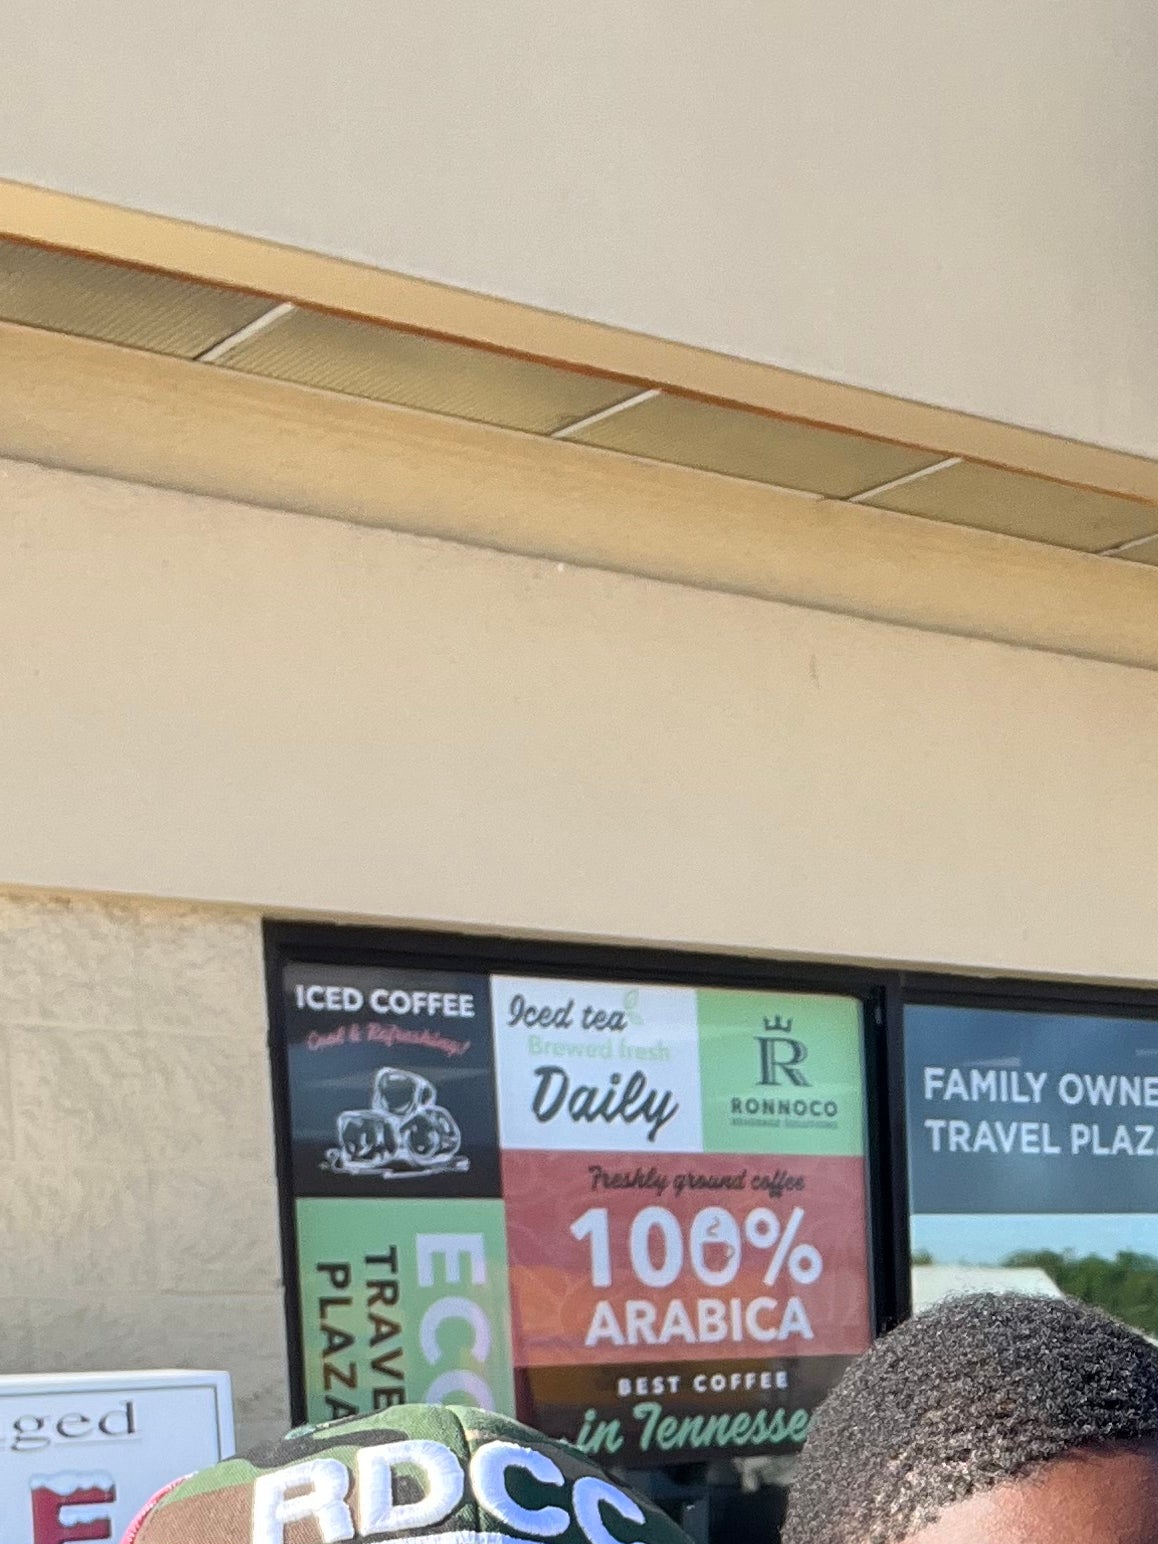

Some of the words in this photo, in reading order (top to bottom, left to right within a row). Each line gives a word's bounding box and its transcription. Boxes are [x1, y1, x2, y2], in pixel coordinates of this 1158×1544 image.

[295, 984, 364, 1012] ICED
[369, 988, 476, 1018] COFFEE
[507, 993, 575, 1029] Iced
[581, 1005, 628, 1031] tea
[528, 1035, 613, 1059] Brewed
[619, 1037, 672, 1061] fresh
[753, 1036, 814, 1088] R
[532, 1065, 680, 1143] Daily
[923, 1066, 1048, 1104] FAMILY
[730, 1097, 838, 1118] RONNOCO
[924, 1119, 1061, 1155] TRAVEL
[588, 1165, 668, 1197] Freshly
[672, 1169, 748, 1198] ground
[751, 1169, 805, 1199] coffee
[570, 1205, 823, 1289] 100%
[364, 1245, 406, 1410] TRAVE
[584, 1296, 815, 1346] ARABICA
[617, 1374, 681, 1397] BEST
[693, 1370, 789, 1393] COFFEE
[576, 1408, 625, 1454] in
[632, 1401, 811, 1451] Tennesse
